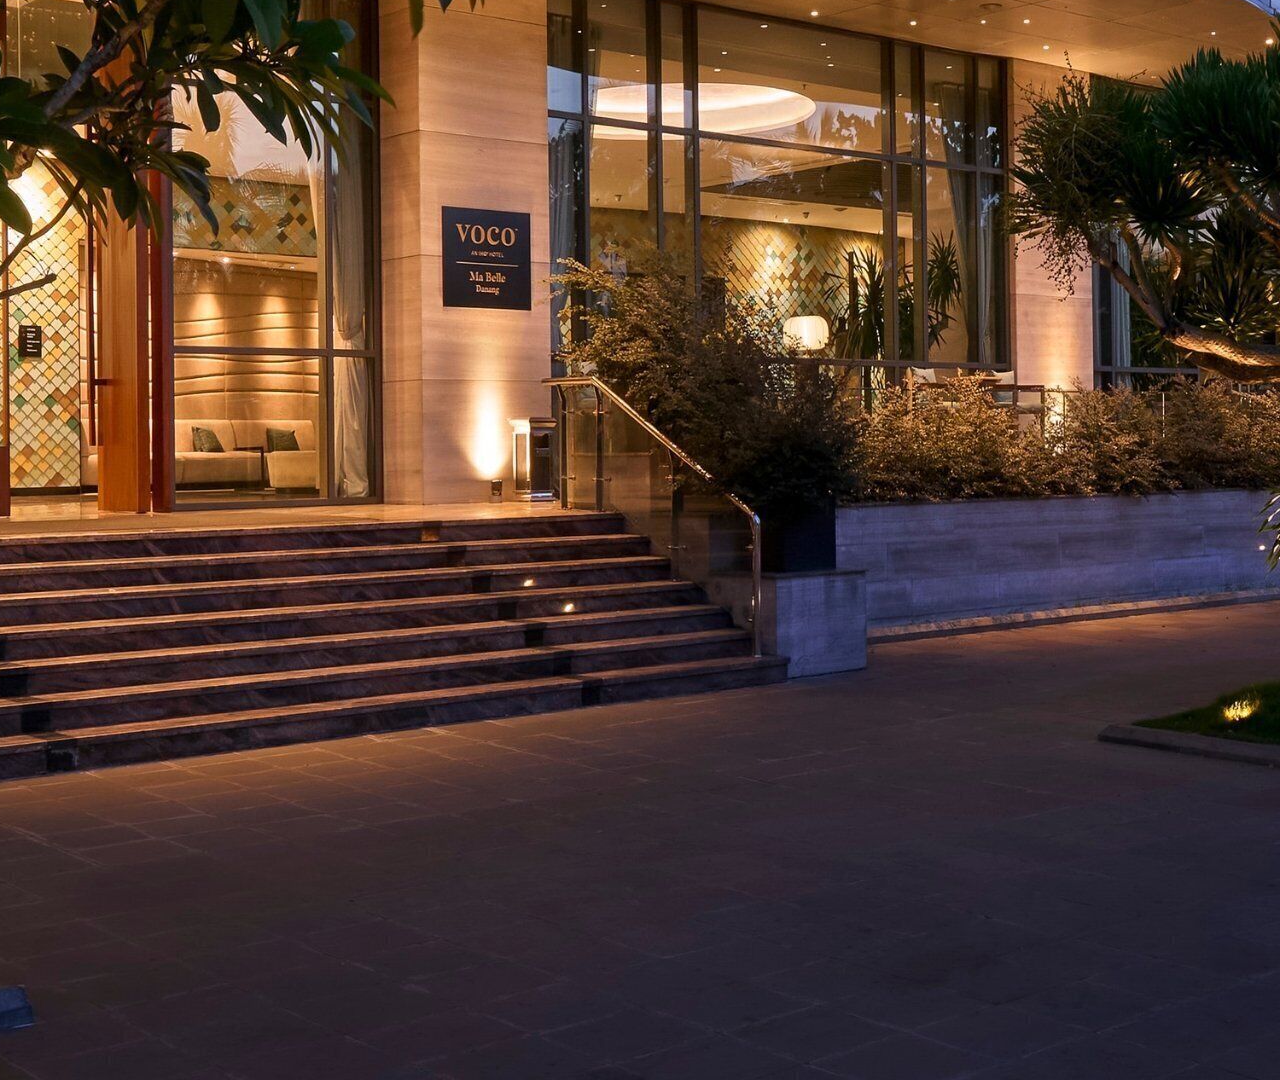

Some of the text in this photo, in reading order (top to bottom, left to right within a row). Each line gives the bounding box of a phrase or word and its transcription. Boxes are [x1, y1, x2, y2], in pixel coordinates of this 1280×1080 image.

[469, 271, 506, 282] Ma Belle
[476, 284, 500, 296] Danang
